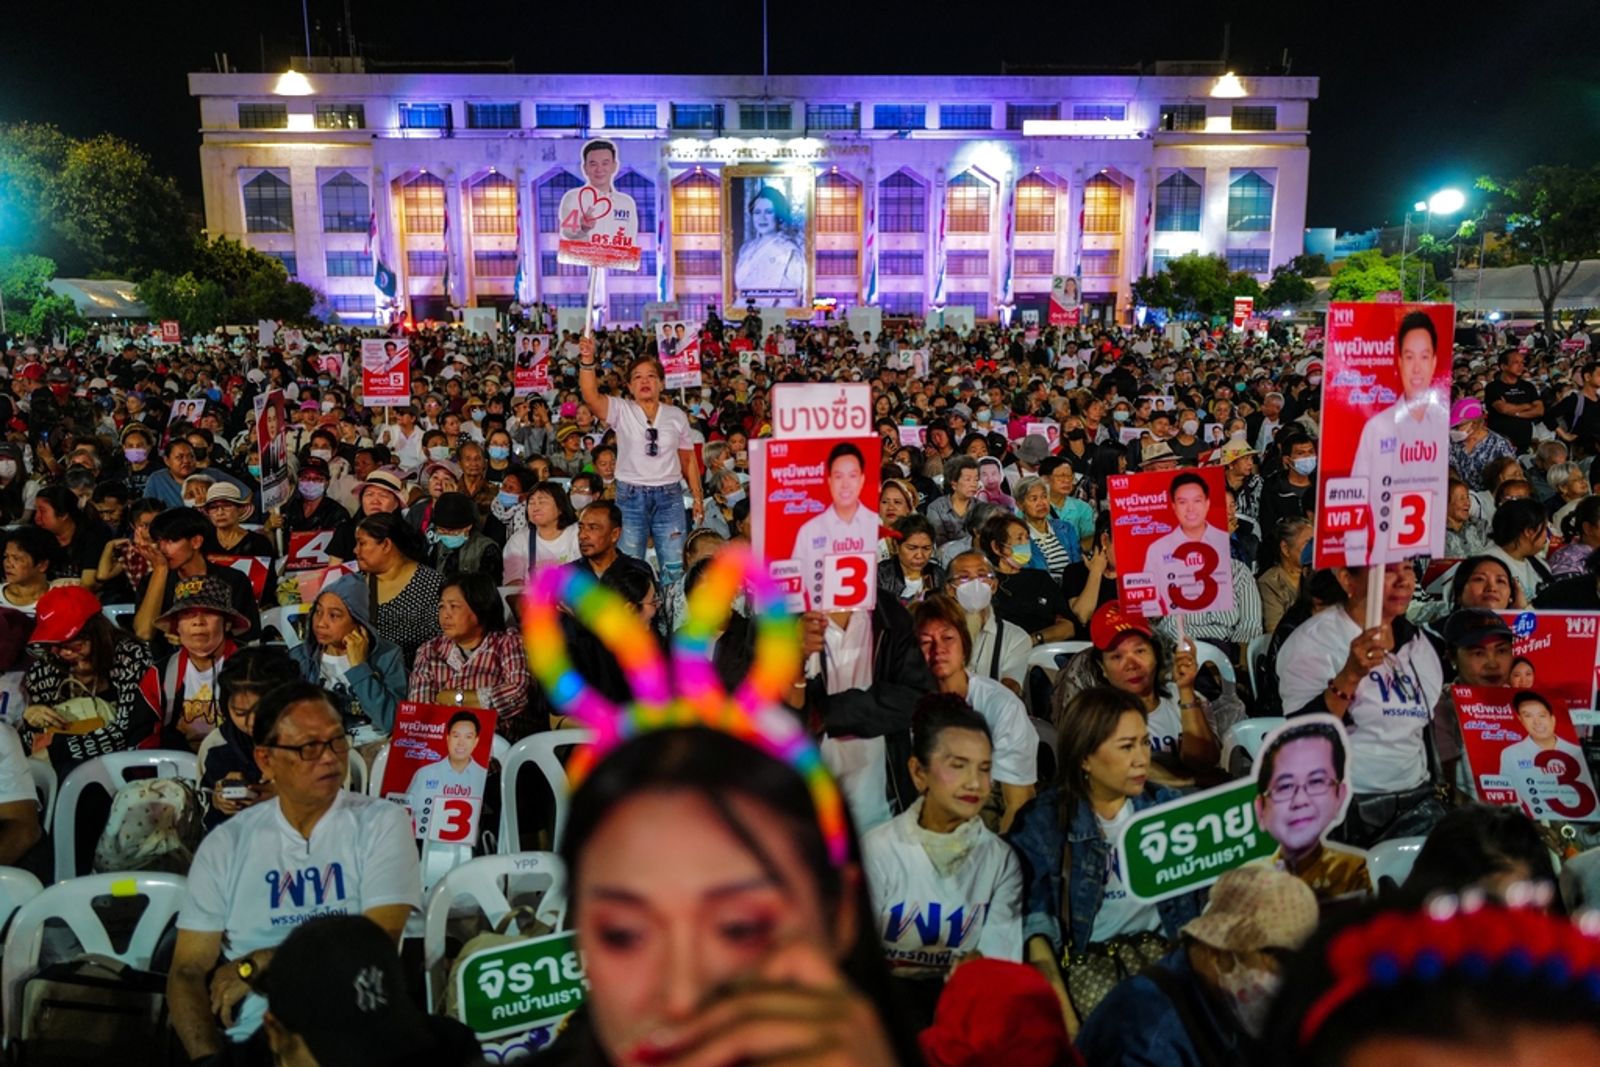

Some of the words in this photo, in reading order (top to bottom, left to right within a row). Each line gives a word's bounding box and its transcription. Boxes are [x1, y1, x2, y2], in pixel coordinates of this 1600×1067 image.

[562, 209, 579, 233] 4
[1054, 277, 1063, 289] 2
[687, 350, 695, 365] 5
[741, 353, 749, 364] 2
[902, 352, 911, 363] 2
[393, 374, 401, 385] 5
[538, 364, 546, 378] 5
[779, 388, 867, 432] บางซื่อ
[1354, 508, 1365, 526] 7
[1397, 494, 1426, 546] 3
[296, 531, 334, 563] 4
[793, 578, 801, 591] 7
[832, 556, 869, 607] 3
[1167, 541, 1220, 612] 3
[1147, 589, 1154, 598] 7
[1565, 617, 1596, 633] พท
[1533, 750, 1596, 818] 3
[1507, 791, 1515, 801] 7
[438, 799, 473, 842] 3
[1138, 802, 1257, 865] จิรายุ
[513, 859, 539, 870] YPP
[1155, 844, 1245, 886] คนบ้านเรา
[265, 862, 346, 909] พท
[491, 986, 582, 1021] คนบ้านเรา
